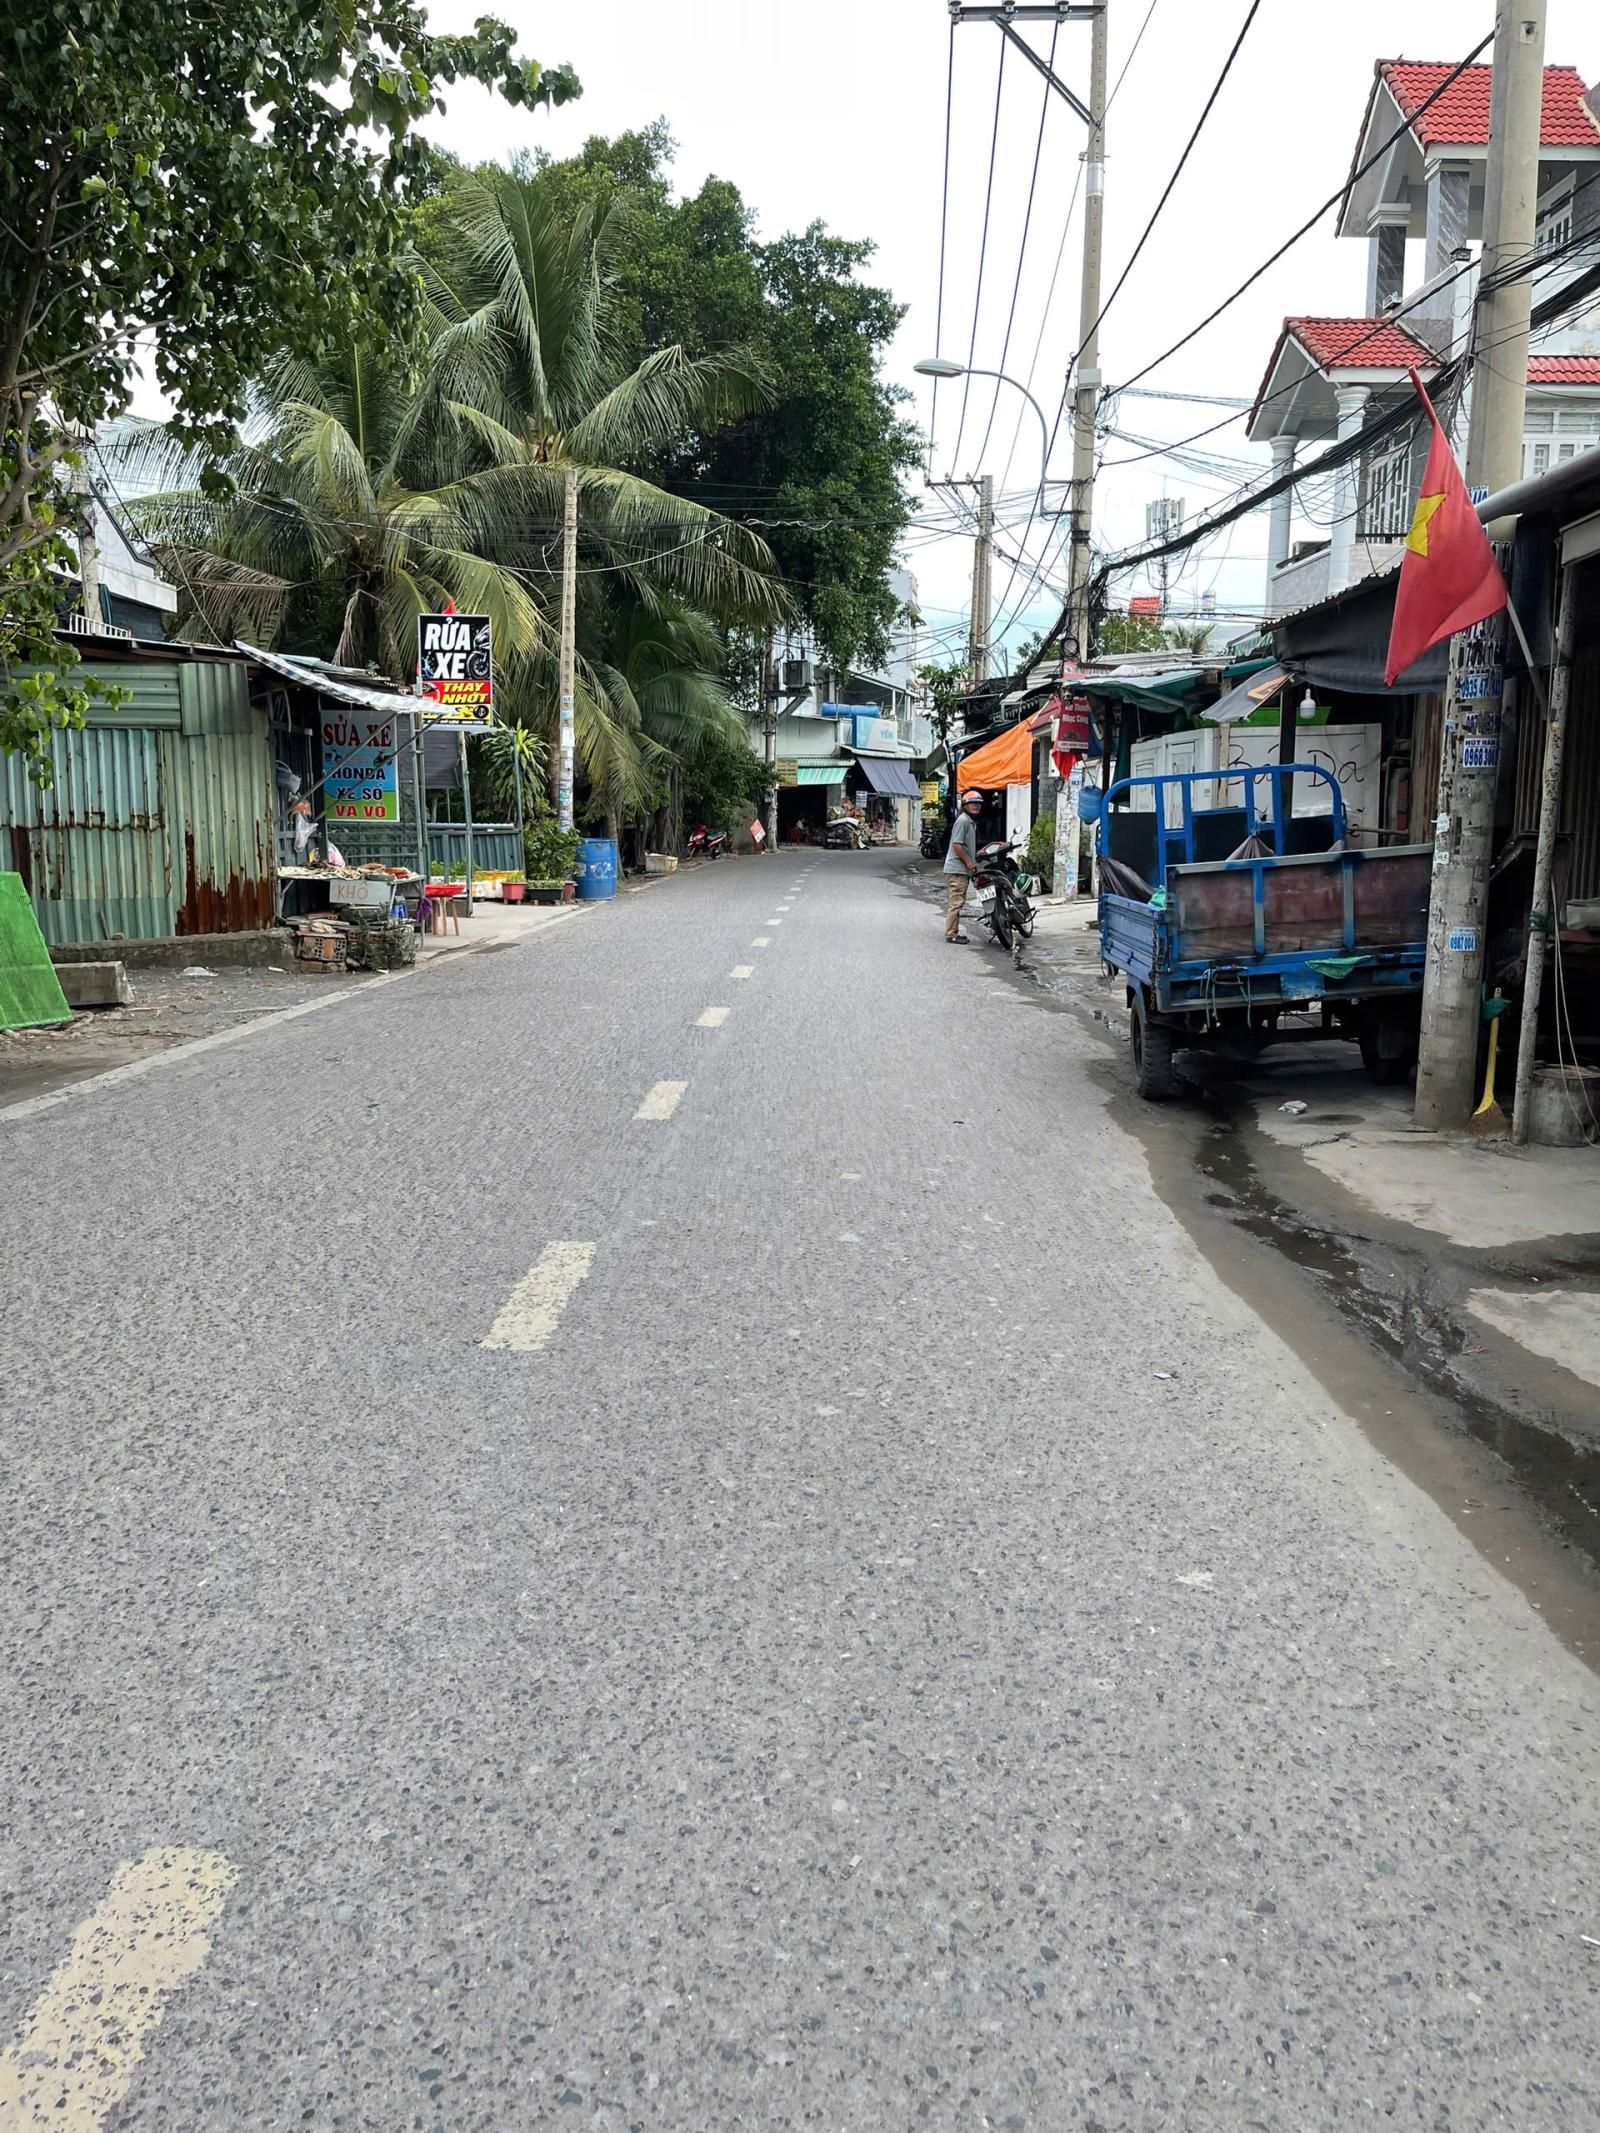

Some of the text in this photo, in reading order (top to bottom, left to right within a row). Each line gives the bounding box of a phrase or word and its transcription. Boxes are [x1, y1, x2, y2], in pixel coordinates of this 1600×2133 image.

[424, 617, 471, 651] RỬA
[432, 653, 467, 679] XE
[443, 682, 485, 692] THAY
[441, 690, 489, 704] NHỚT
[323, 713, 392, 747] SỬA XE
[1464, 748, 1483, 766] 0968
[331, 767, 386, 780] HONDA
[337, 783, 383, 801] XE SỐ
[335, 881, 369, 900] KHÔ
